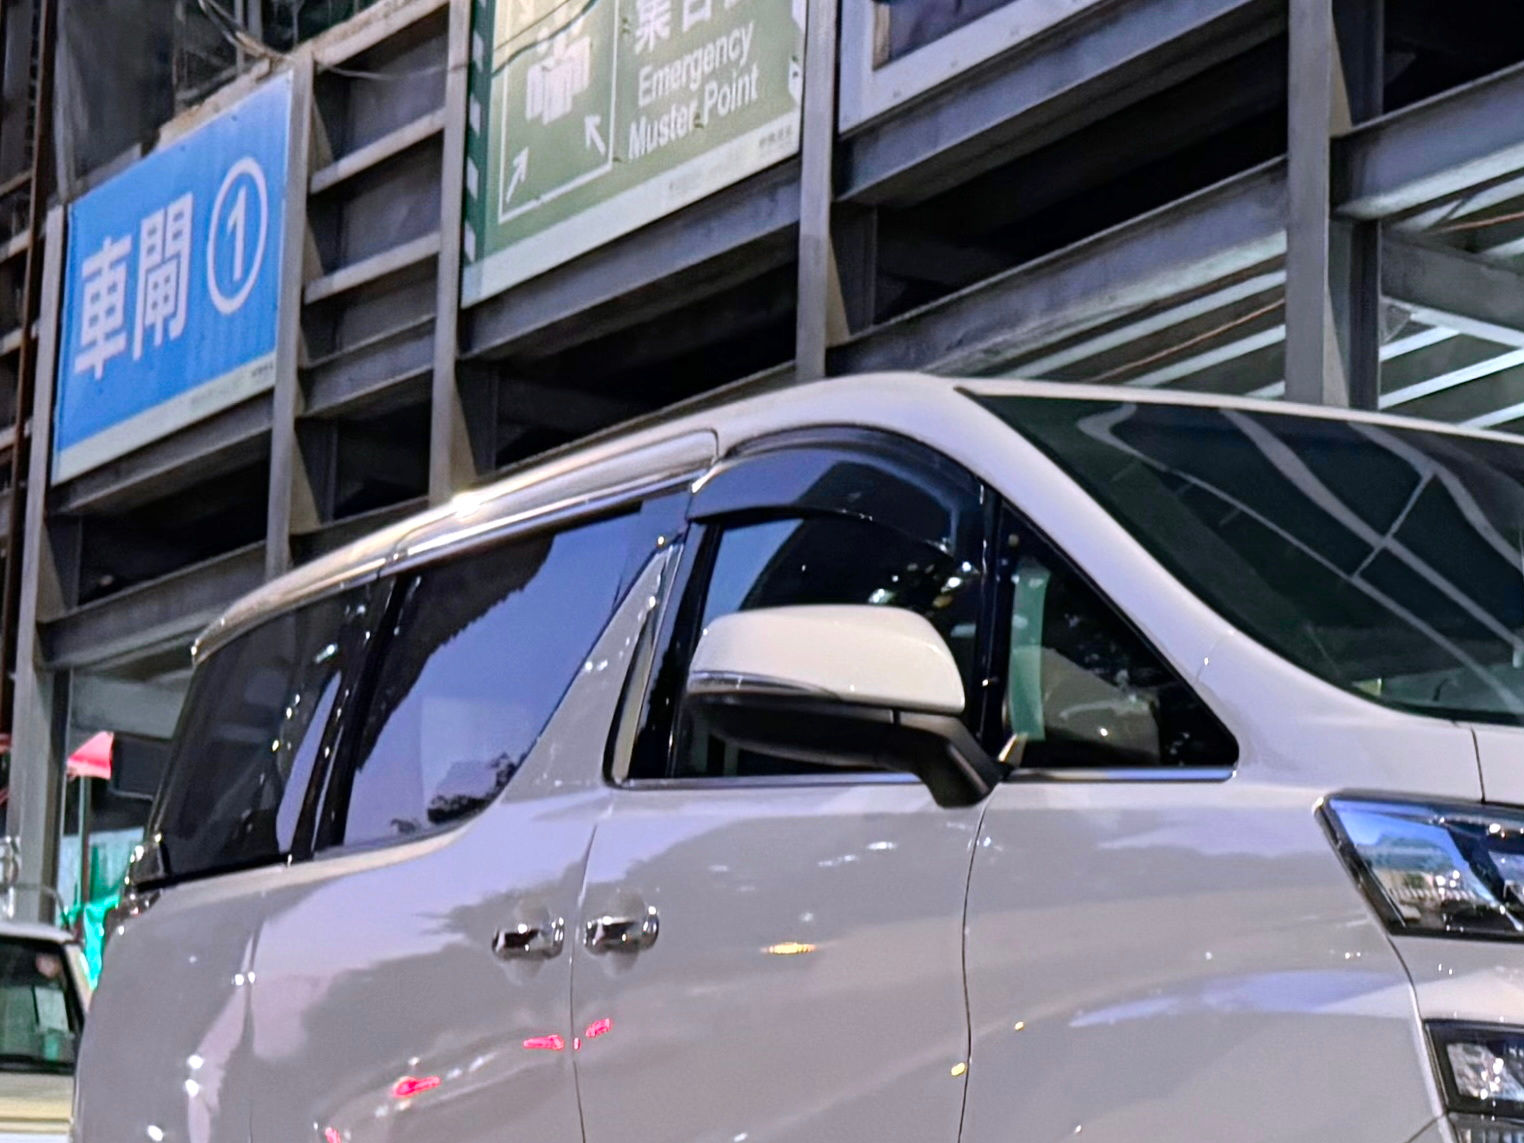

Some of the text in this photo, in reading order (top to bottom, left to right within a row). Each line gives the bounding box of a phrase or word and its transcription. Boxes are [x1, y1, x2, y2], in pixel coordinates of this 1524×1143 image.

[628, 61, 759, 160] Muster Point
[638, 20, 754, 108] Emergency
[74, 191, 194, 381] 車閘
